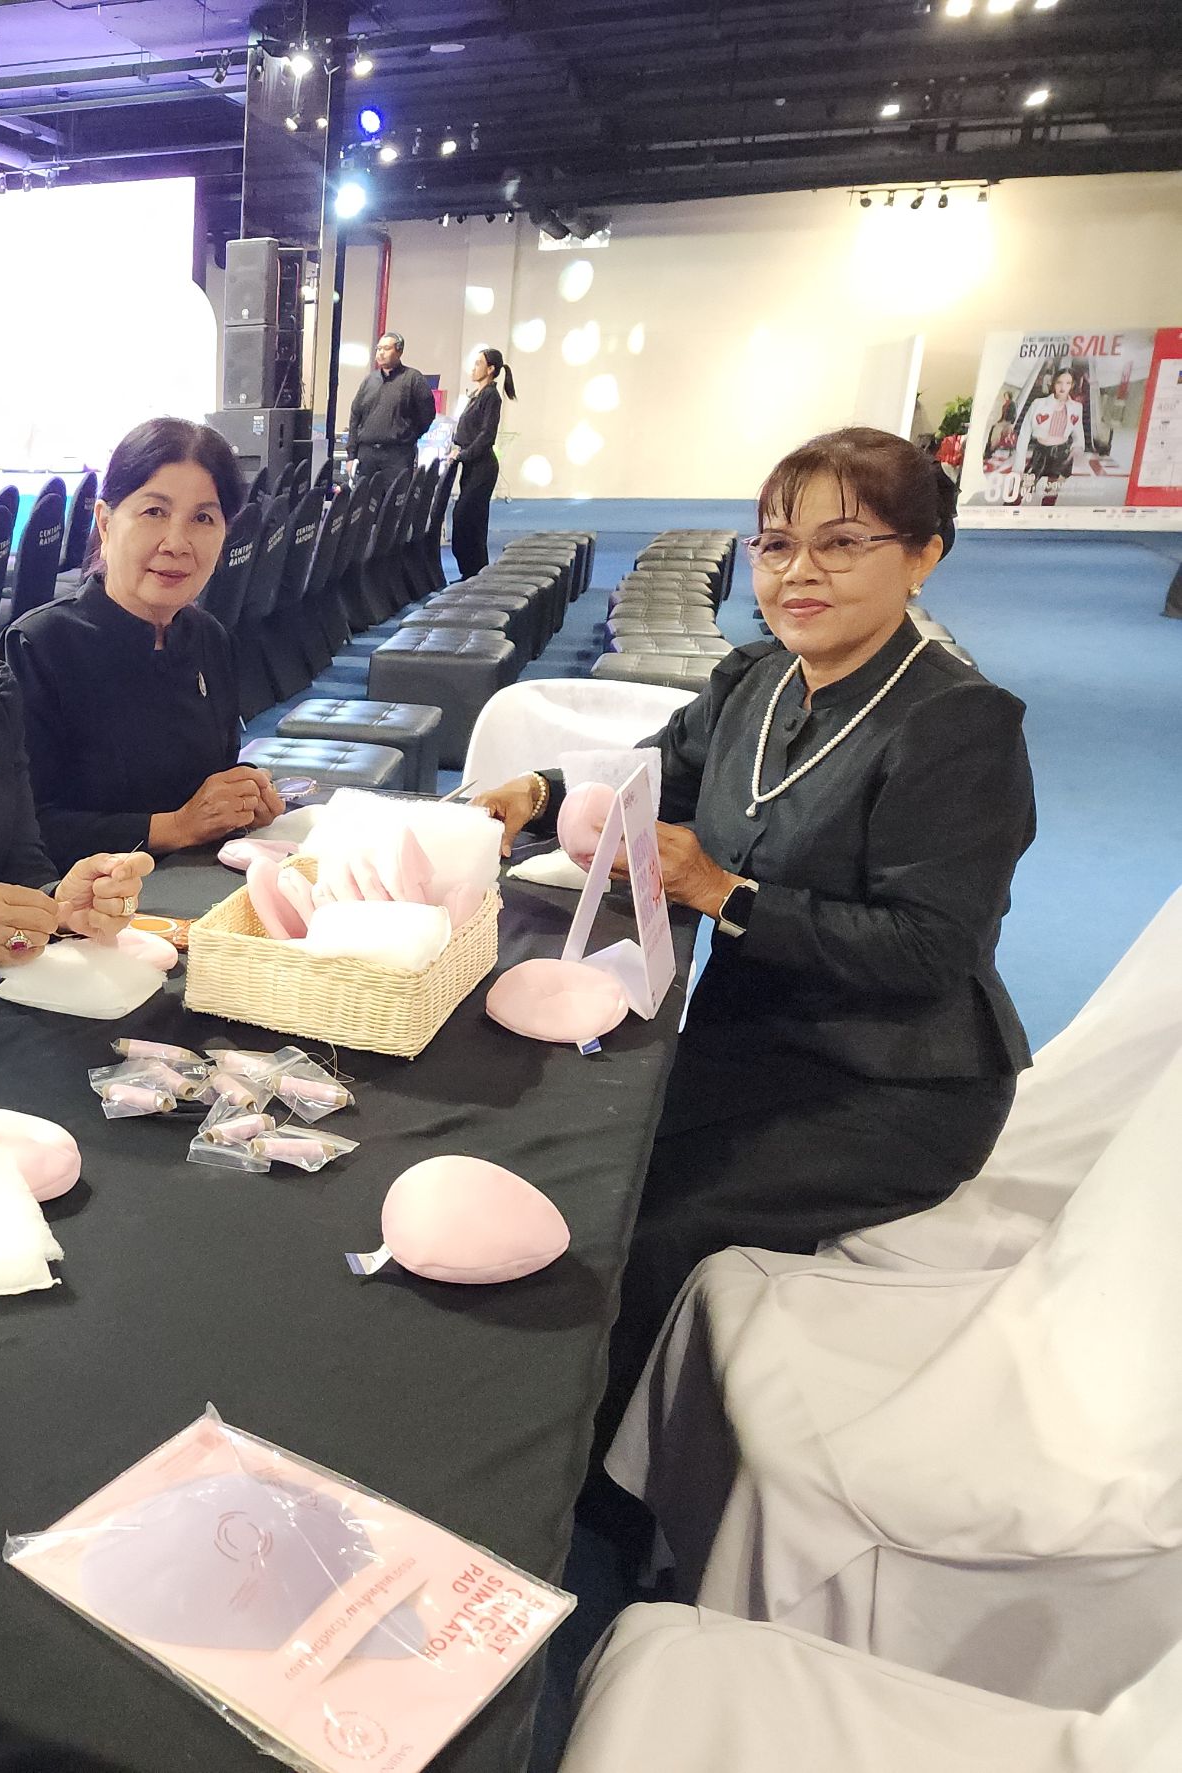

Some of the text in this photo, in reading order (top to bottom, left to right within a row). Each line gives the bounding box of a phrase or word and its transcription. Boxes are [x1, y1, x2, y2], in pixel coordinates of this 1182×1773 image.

[1019, 334, 1123, 358] GRAND SALE
[452, 1562, 485, 1595] PAD
[424, 1575, 504, 1661] SIMULATOR
[488, 1595, 546, 1655] BEAST
[379, 1744, 415, 1773] SABIN
